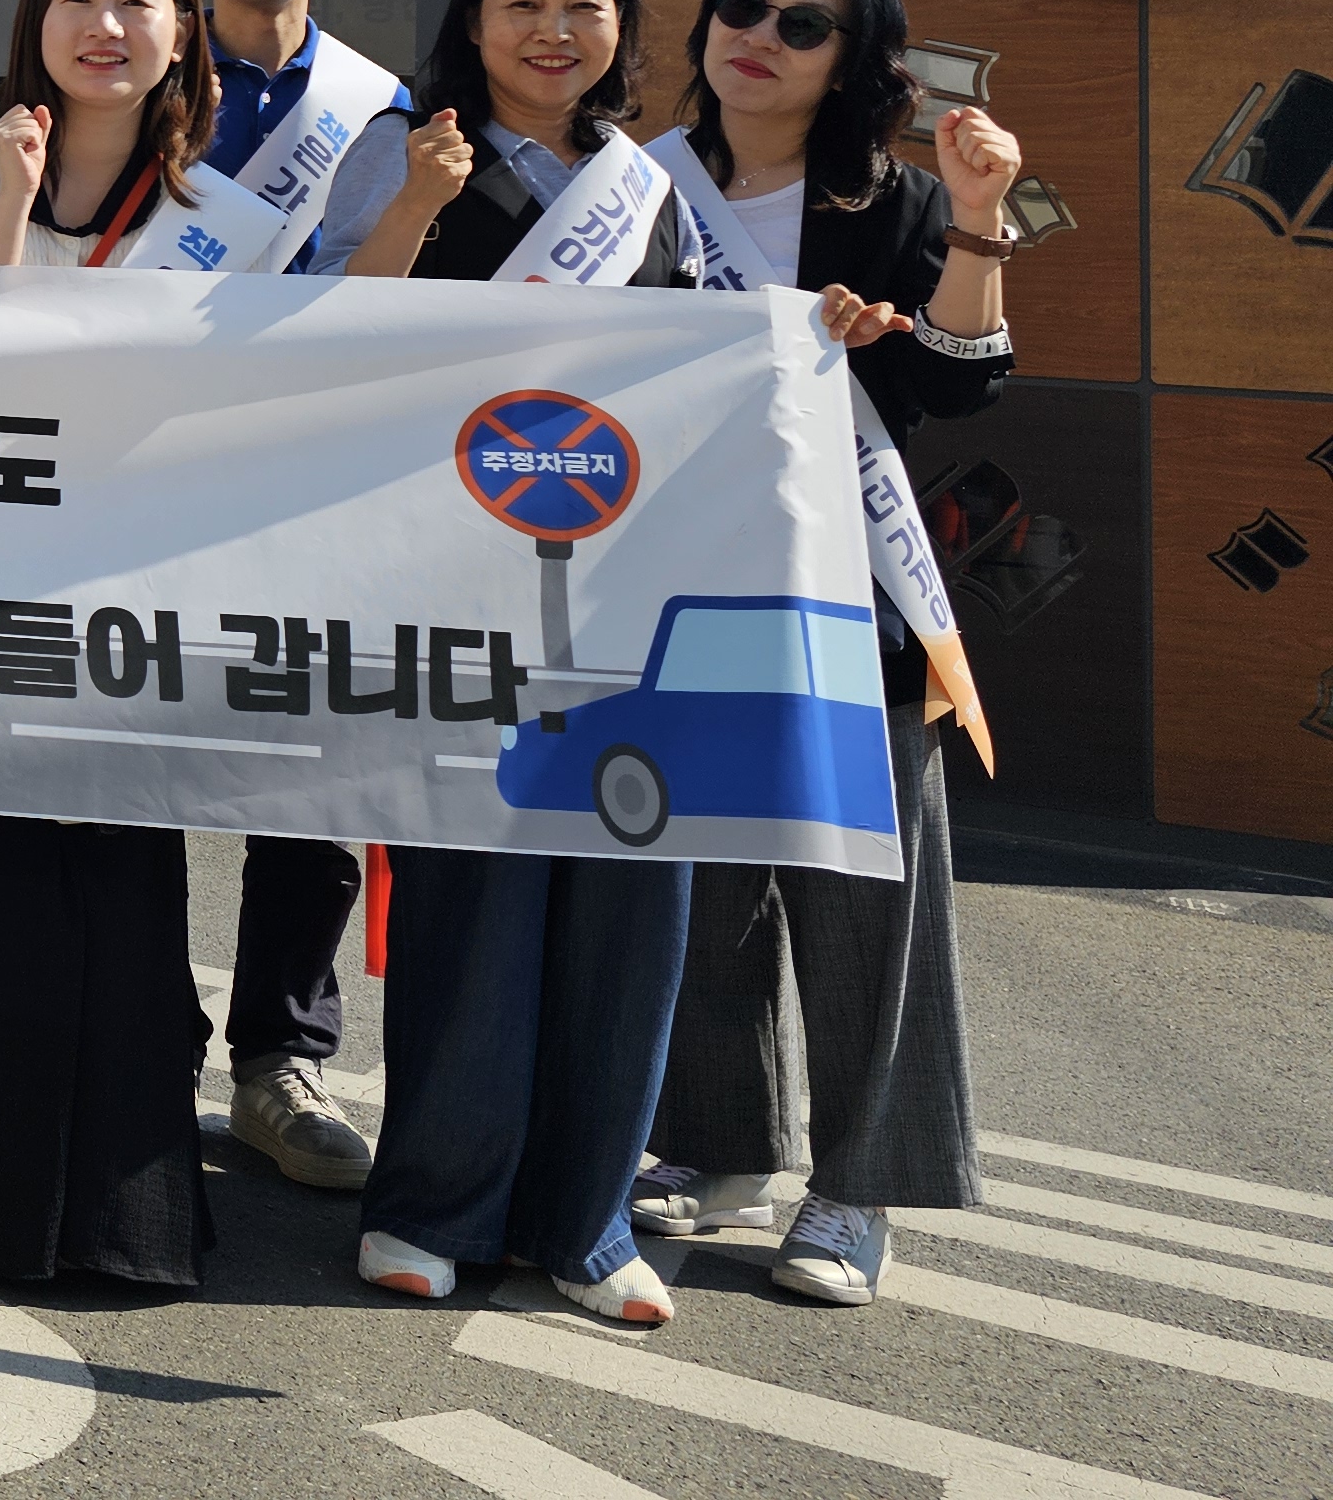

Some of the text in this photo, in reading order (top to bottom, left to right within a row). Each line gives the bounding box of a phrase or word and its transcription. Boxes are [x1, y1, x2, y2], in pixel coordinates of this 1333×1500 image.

[292, 108, 351, 180] 책은
[549, 187, 634, 285] 가까이
[481, 451, 616, 476] 주정차금지
[219, 612, 567, 734] 갑니다.
